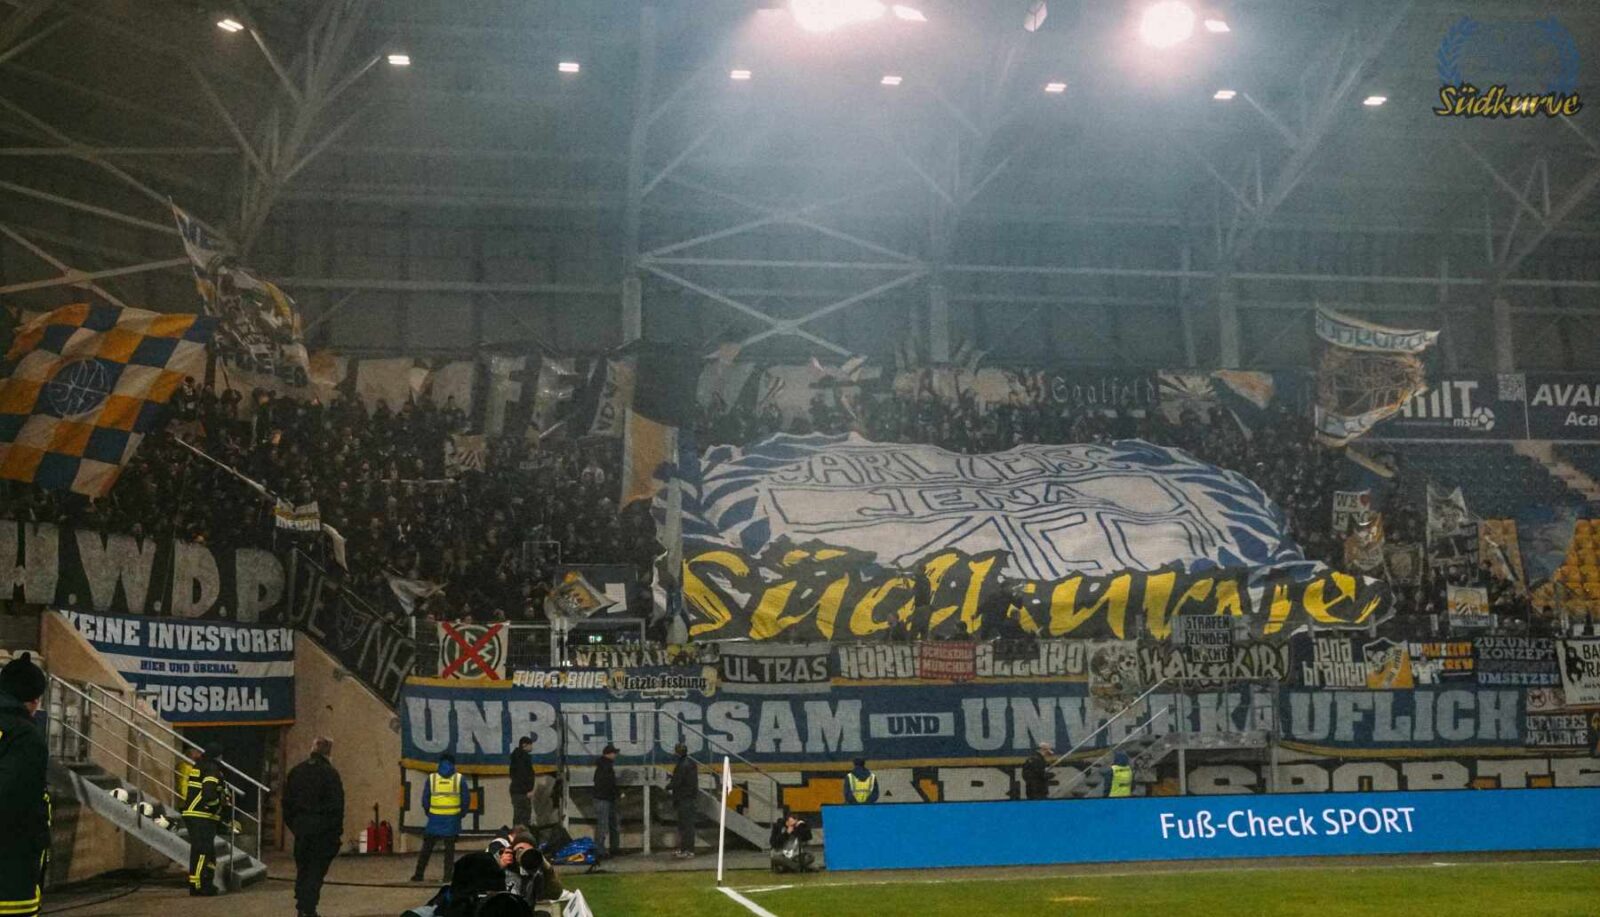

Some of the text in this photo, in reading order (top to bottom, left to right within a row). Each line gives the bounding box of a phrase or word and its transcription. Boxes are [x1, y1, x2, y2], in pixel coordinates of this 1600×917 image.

[1531, 383, 1600, 407] AVA
[857, 482, 1084, 517] JENA
[148, 621, 294, 653] INVESTOREN
[140, 660, 238, 675] HIER UND ÜBERALL
[723, 656, 828, 683] ULTRAS
[1478, 672, 1560, 685] UMSETZEN
[404, 697, 864, 756] UNBEUGSAM
[887, 716, 941, 735] UND
[1160, 807, 1415, 840] Fuß-Check SPORT
